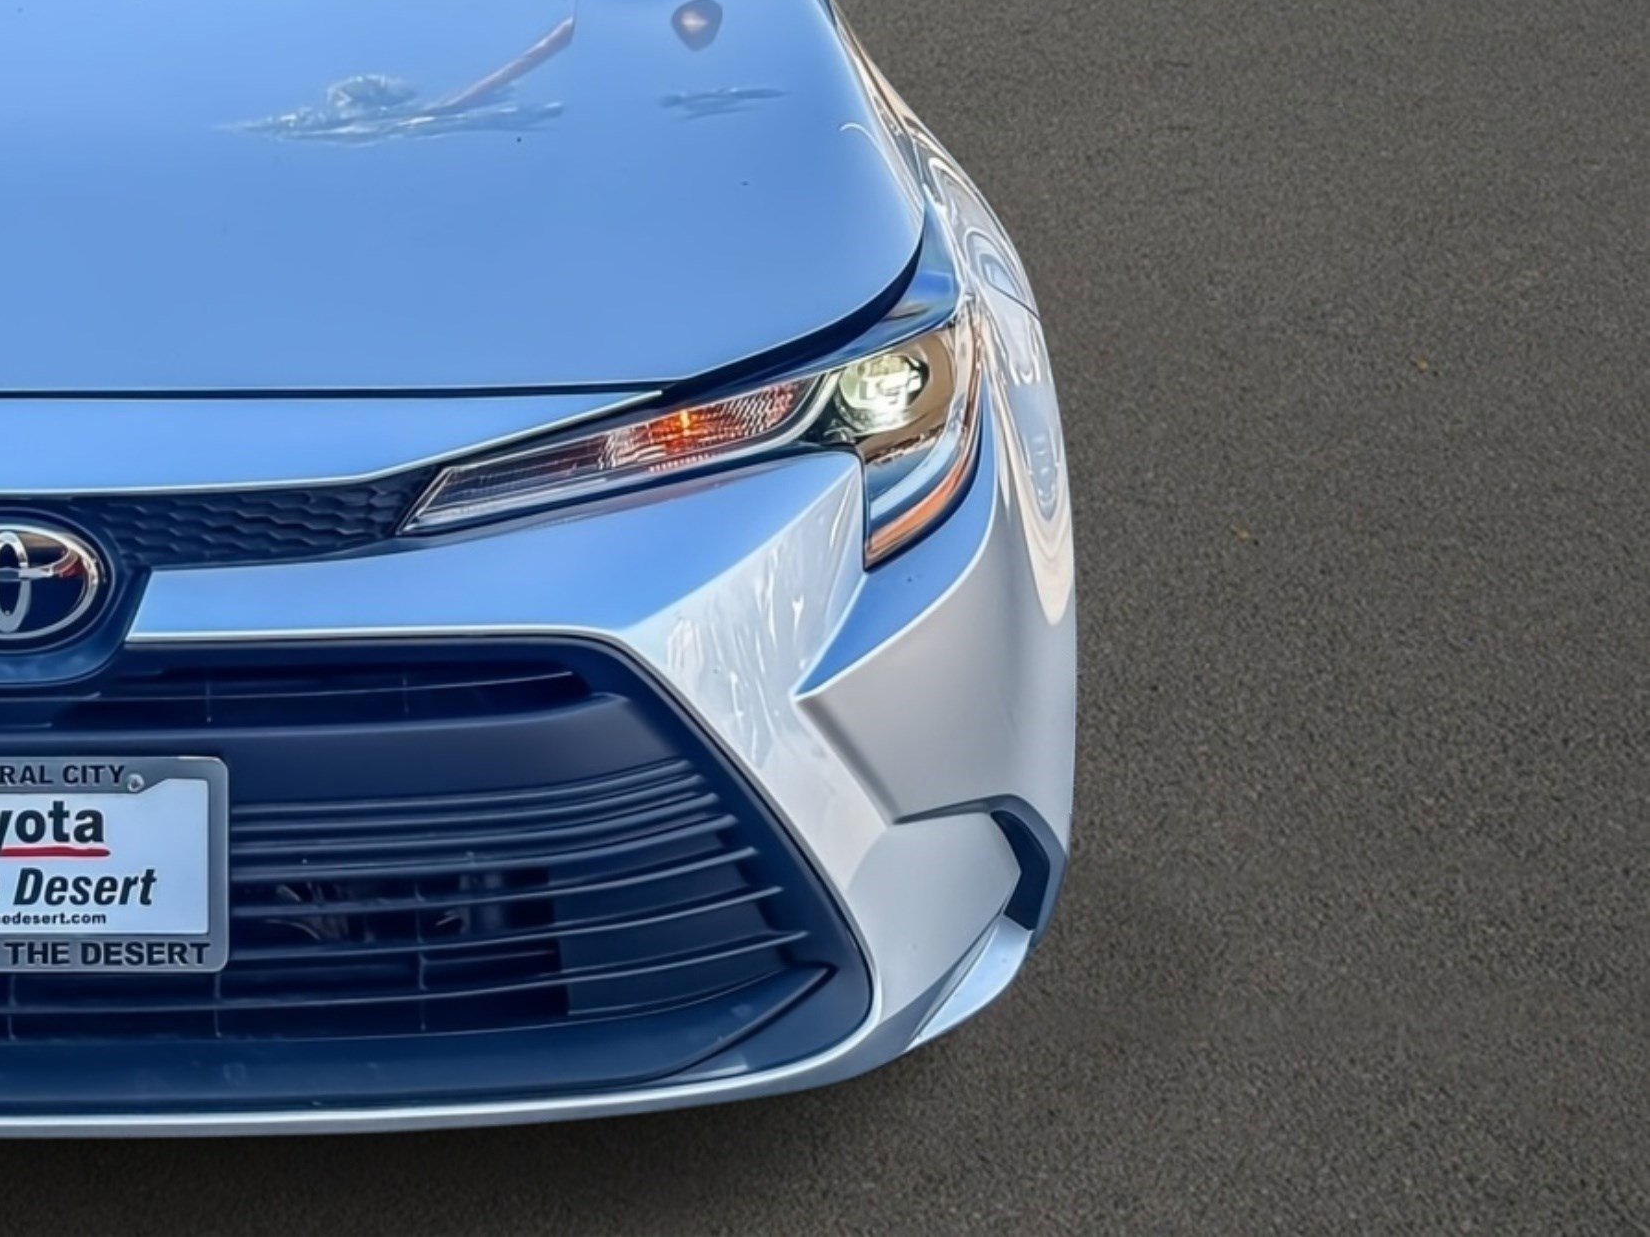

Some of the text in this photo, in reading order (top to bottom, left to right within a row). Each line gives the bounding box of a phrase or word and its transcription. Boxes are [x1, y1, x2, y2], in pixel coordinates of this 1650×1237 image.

[62, 764, 125, 785] CITY
[13, 868, 156, 906] Desert
[4, 942, 70, 965] THE
[80, 942, 211, 965] DESERT
